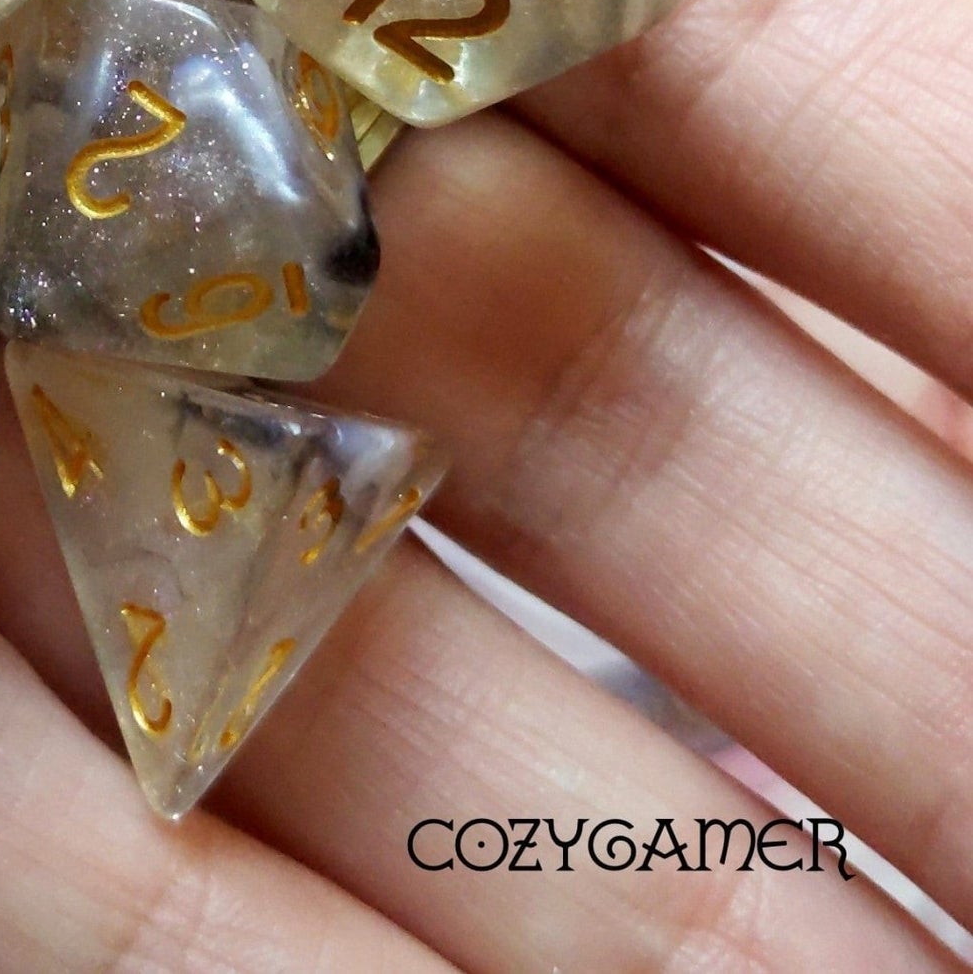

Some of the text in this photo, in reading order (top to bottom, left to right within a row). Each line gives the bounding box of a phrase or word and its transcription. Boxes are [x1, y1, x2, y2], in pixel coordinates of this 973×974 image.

[66, 80, 187, 219] 2
[172, 437, 252, 537] 3
[119, 601, 173, 739] 2
